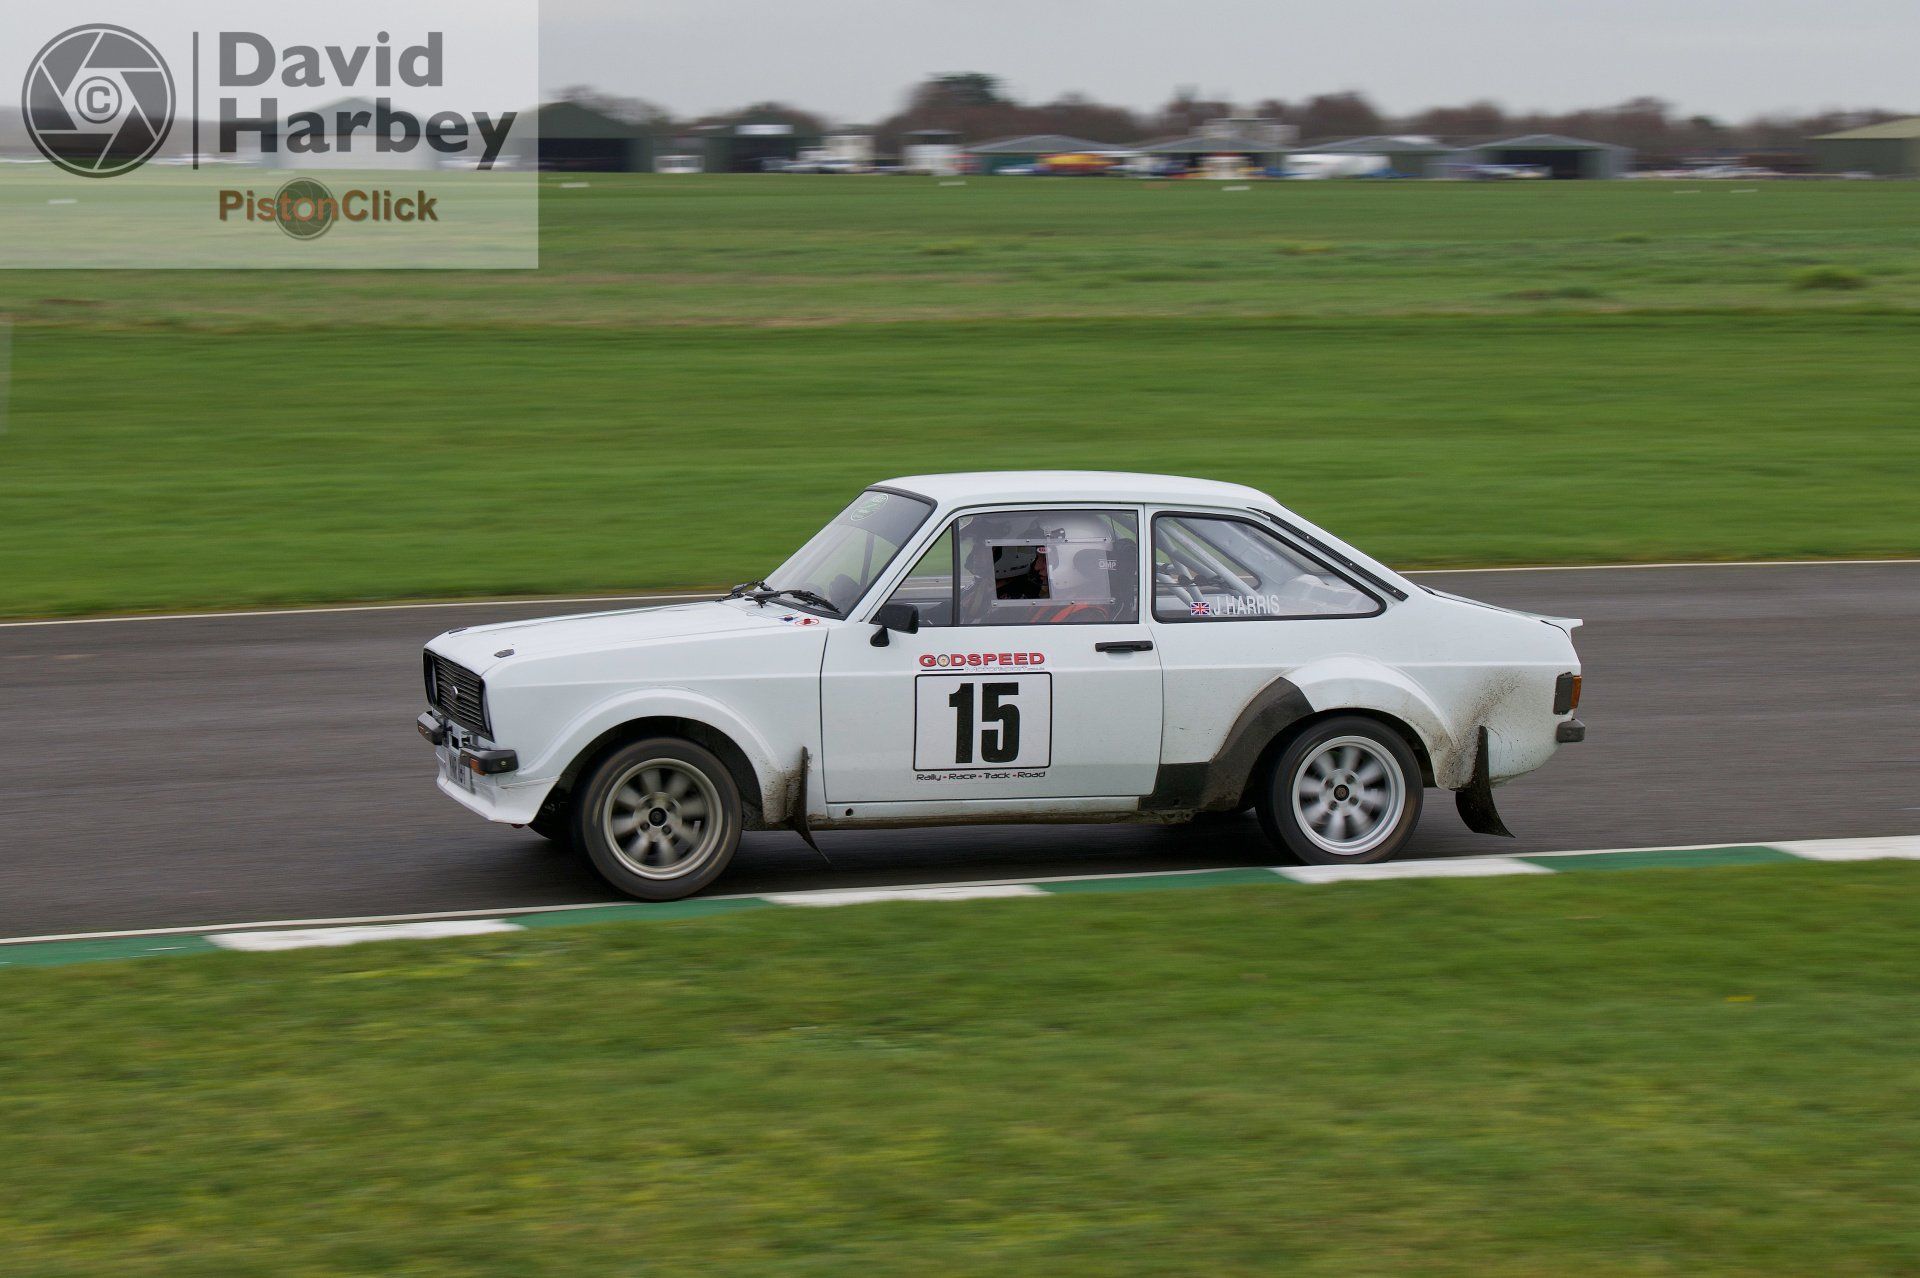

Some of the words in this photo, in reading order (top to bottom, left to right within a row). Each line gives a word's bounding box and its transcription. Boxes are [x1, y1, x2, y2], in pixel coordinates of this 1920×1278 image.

[1213, 596, 1220, 615] J
[1225, 594, 1280, 615] HARRIS
[918, 652, 1045, 667] GODSPEED
[949, 682, 1020, 763] 15
[983, 771, 1010, 779] Track
